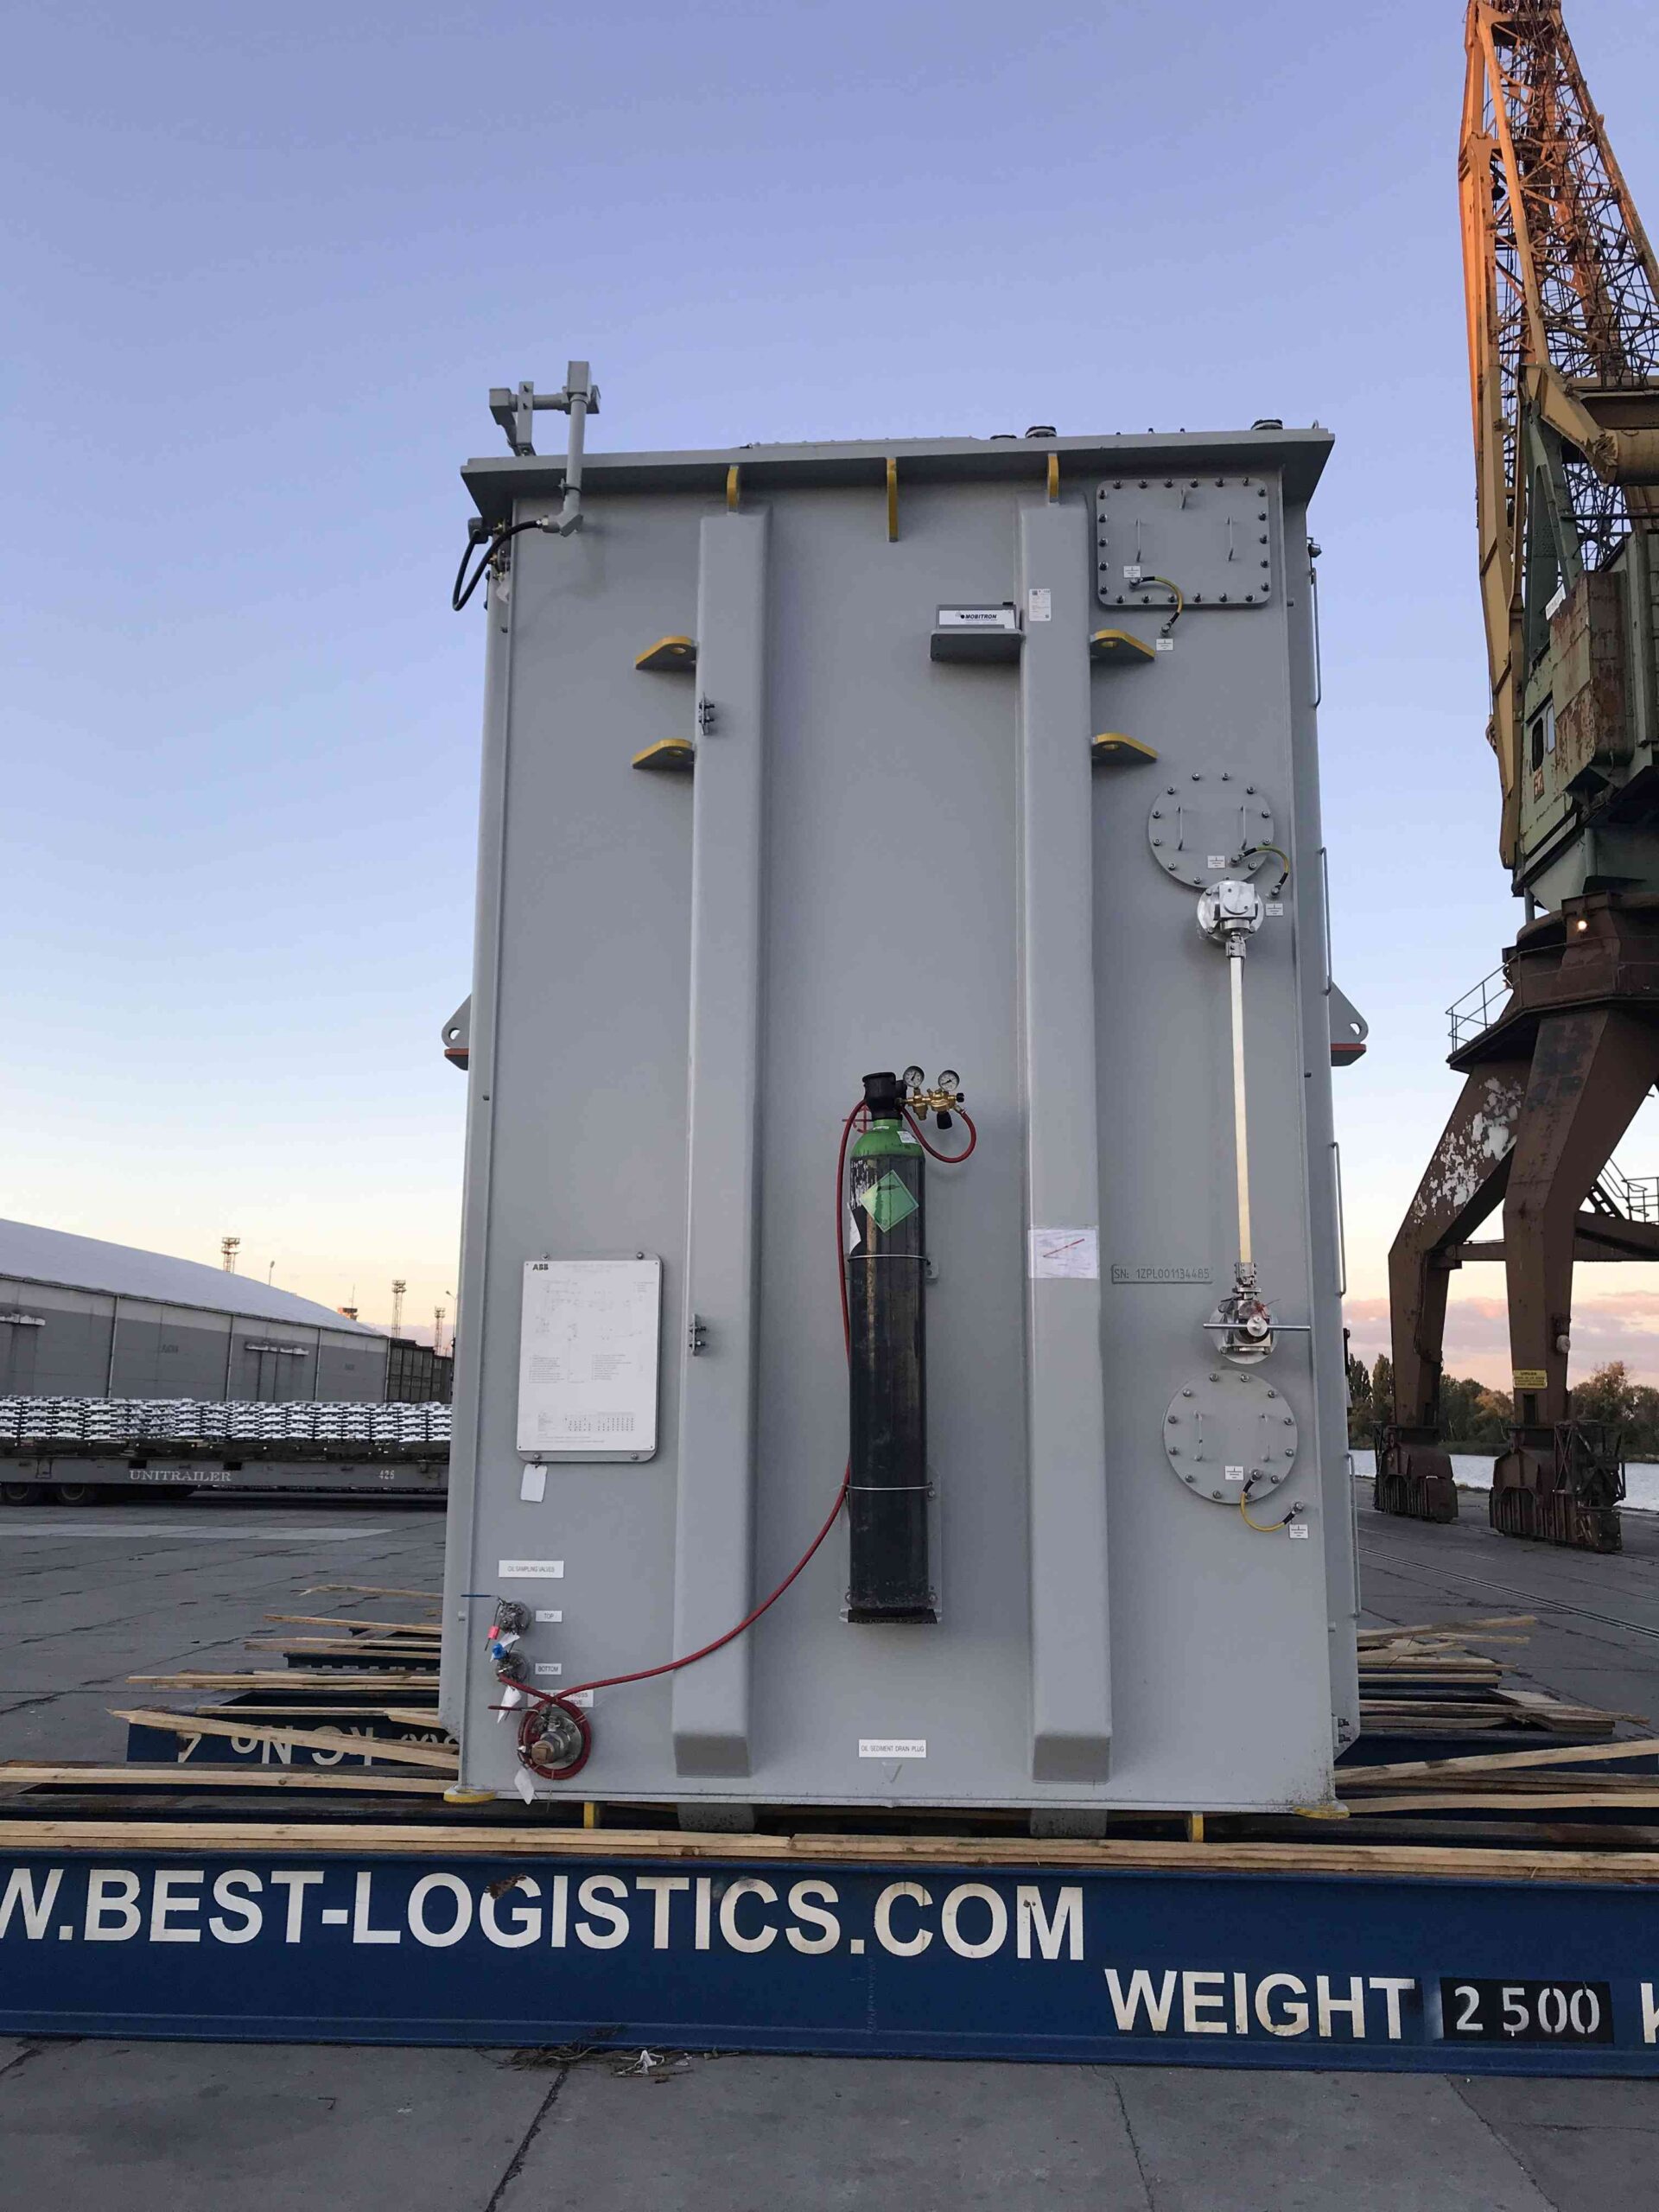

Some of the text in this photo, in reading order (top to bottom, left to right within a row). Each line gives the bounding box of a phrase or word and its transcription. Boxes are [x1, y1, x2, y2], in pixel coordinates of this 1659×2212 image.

[1114, 1268, 1129, 1279] SN:
[130, 1470, 232, 1482] UNITRAILER
[1104, 1969, 1416, 2039] WEIGHT
